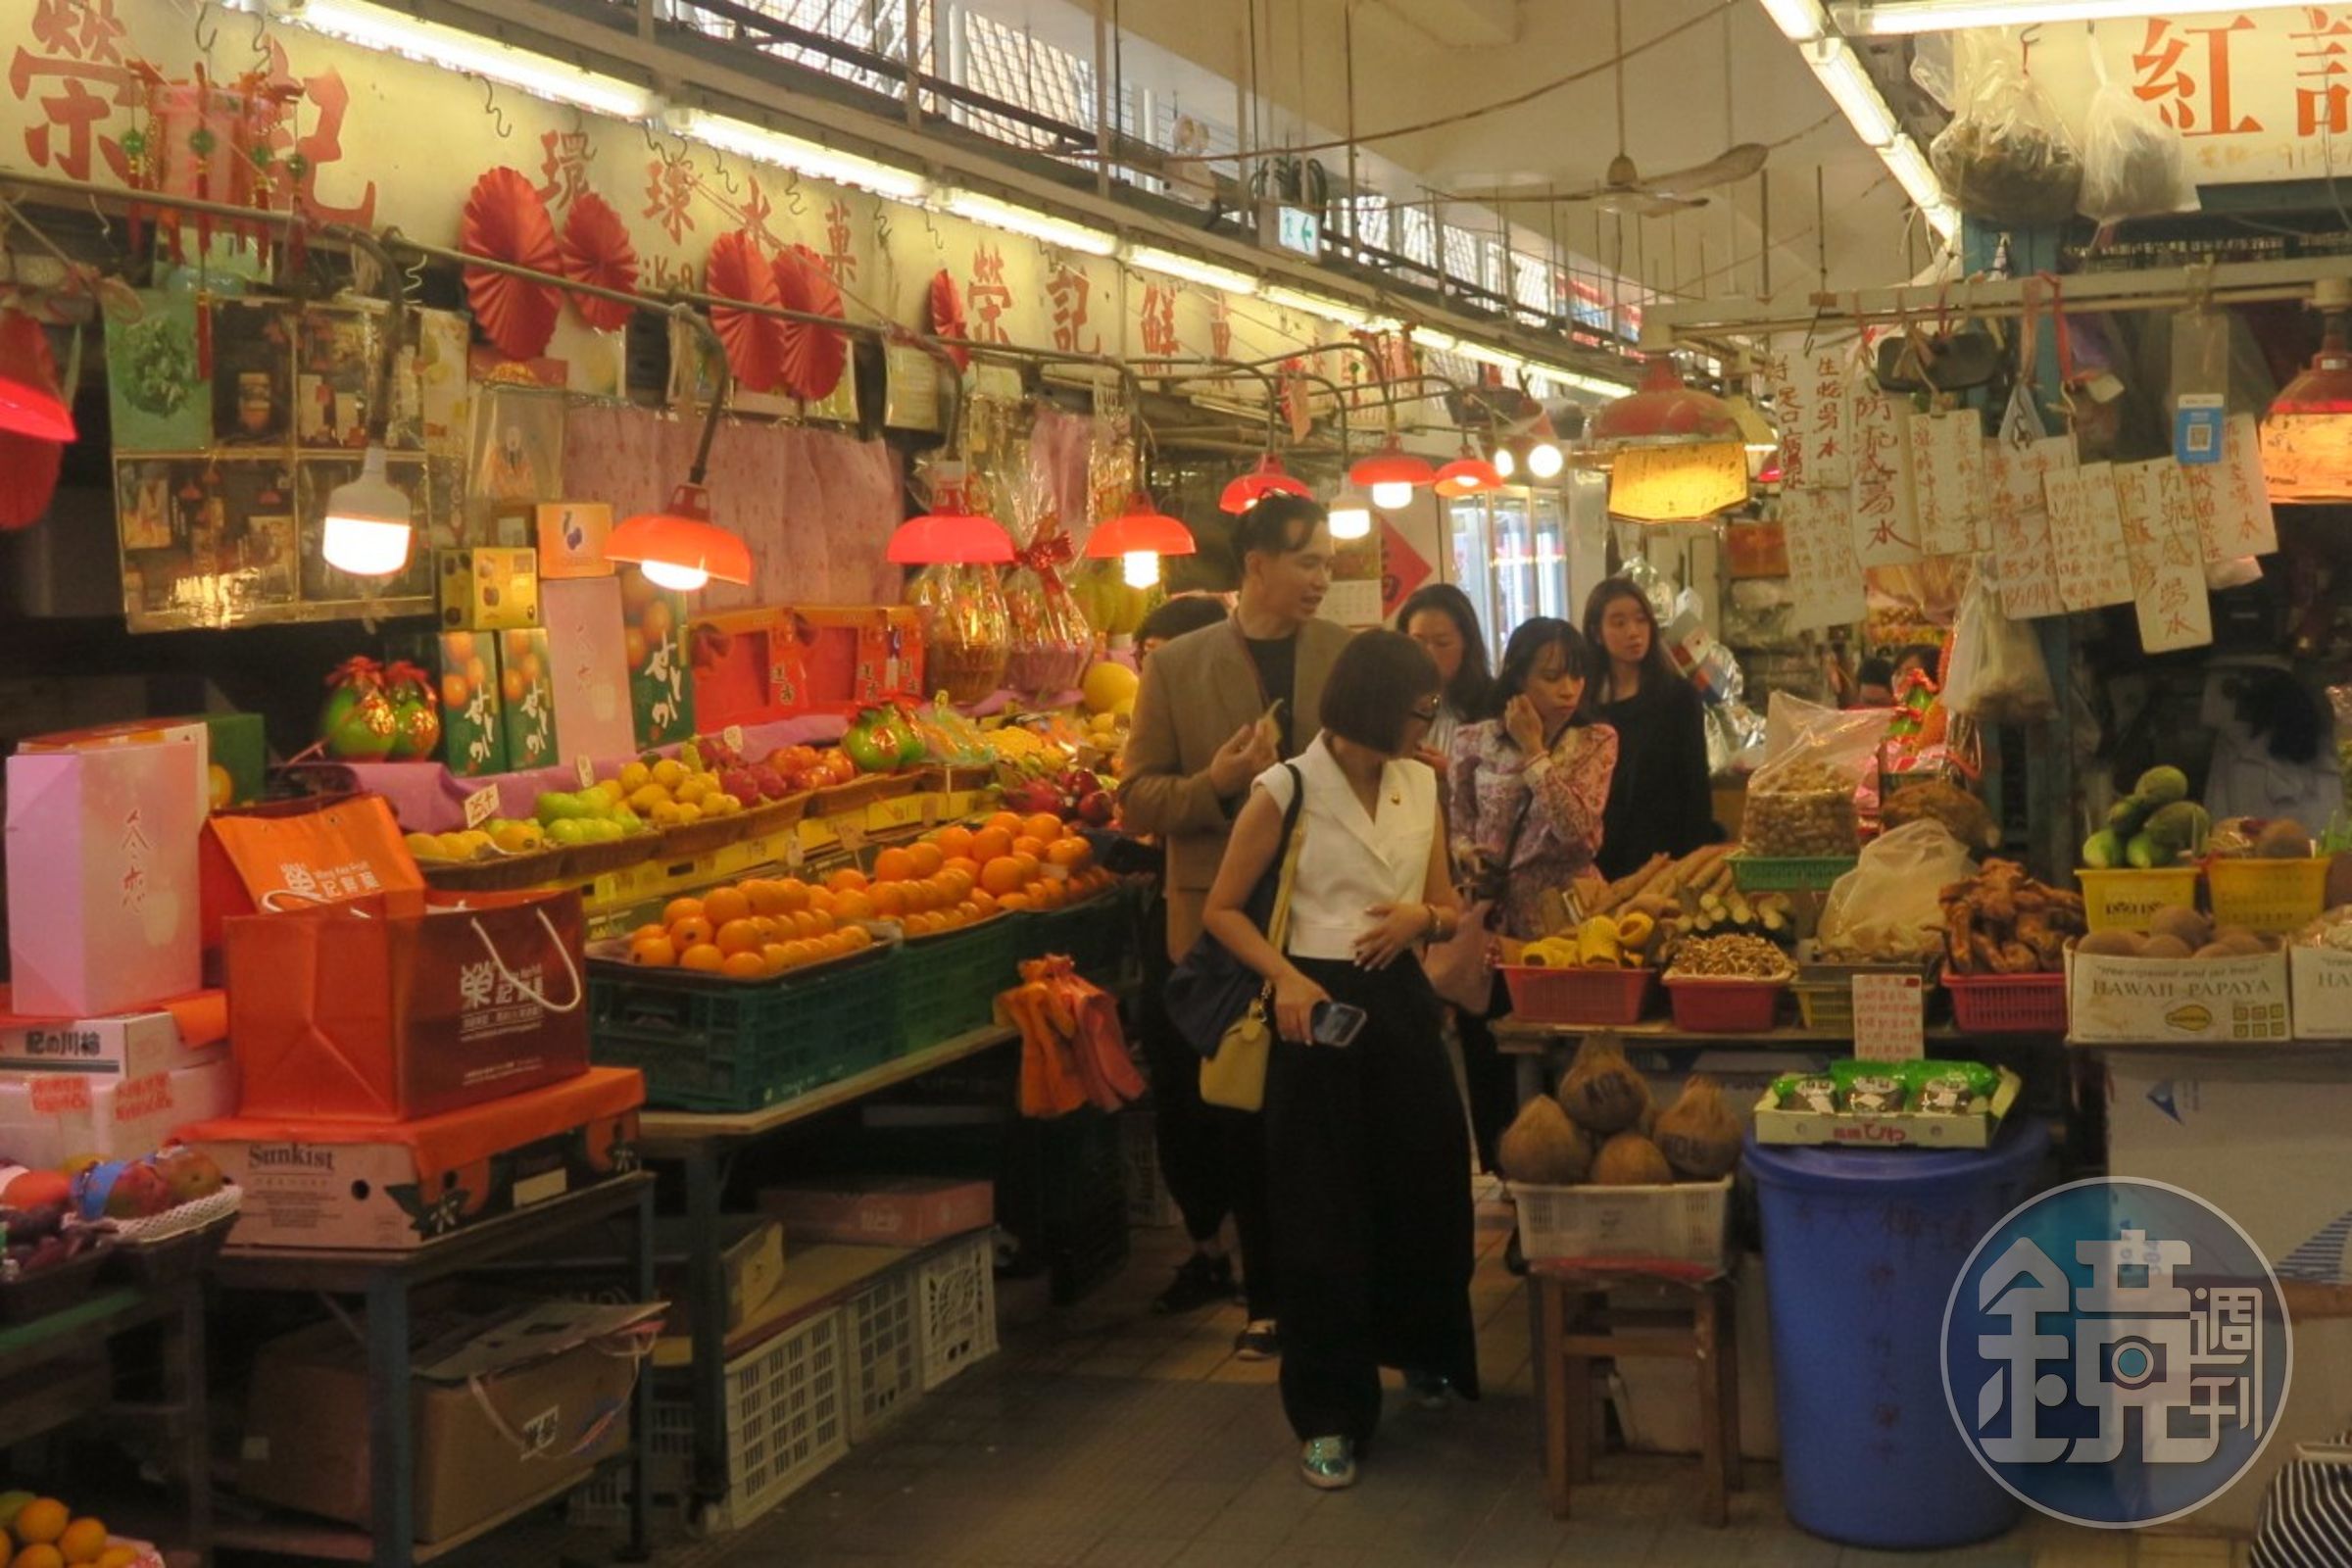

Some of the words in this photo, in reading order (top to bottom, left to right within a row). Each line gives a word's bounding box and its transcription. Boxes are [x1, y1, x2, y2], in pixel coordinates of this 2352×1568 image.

[2092, 979, 2175, 998] HAWAII
[2186, 979, 2272, 998] PAPAYA
[249, 1142, 336, 1171] Sunkist
